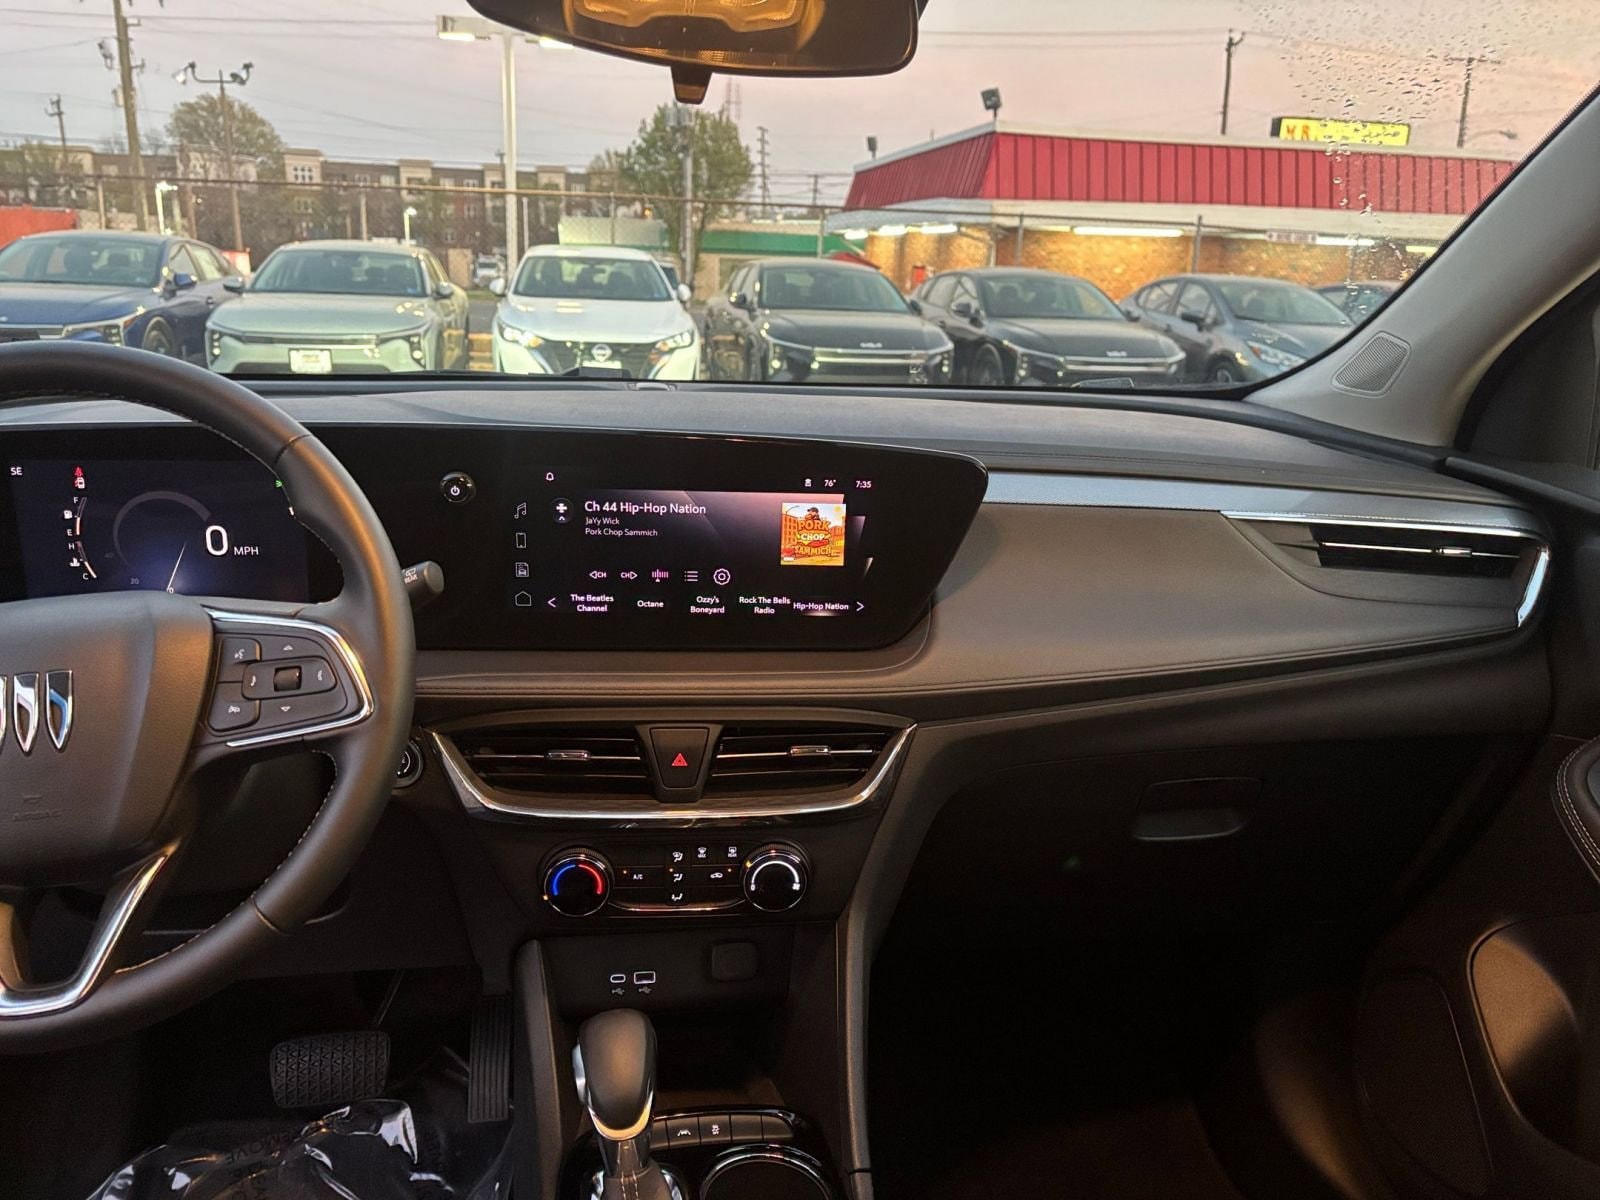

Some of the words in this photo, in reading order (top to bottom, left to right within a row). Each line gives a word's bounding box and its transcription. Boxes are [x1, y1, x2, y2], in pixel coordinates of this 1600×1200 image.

[10, 466, 23, 476] SE
[856, 480, 872, 489] 7:35
[584, 500, 600, 512] Ch
[602, 501, 618, 512] 44
[619, 501, 667, 516] Hip-Hop
[669, 503, 706, 514] Nation
[585, 517, 601, 526] JaYy
[602, 517, 620, 525] Wick
[798, 519, 831, 531] PORK
[584, 527, 602, 536] Pork
[603, 527, 623, 537] Chop
[624, 528, 658, 537] Sammich
[800, 532, 826, 541] CHOP
[205, 525, 229, 556] 0
[233, 546, 260, 556] MPH
[570, 594, 586, 602] The
[586, 594, 614, 602] Beatles
[696, 596, 720, 605] Ozzy's
[739, 596, 757, 604] Rock
[758, 596, 772, 604] The
[773, 596, 791, 605] Bells
[576, 604, 608, 612] Channel
[637, 600, 664, 608] Octane
[793, 602, 824, 611] Hip-Hop
[824, 602, 849, 611] Nation
[690, 605, 725, 615] Boneyard
[754, 606, 775, 614] Radio
